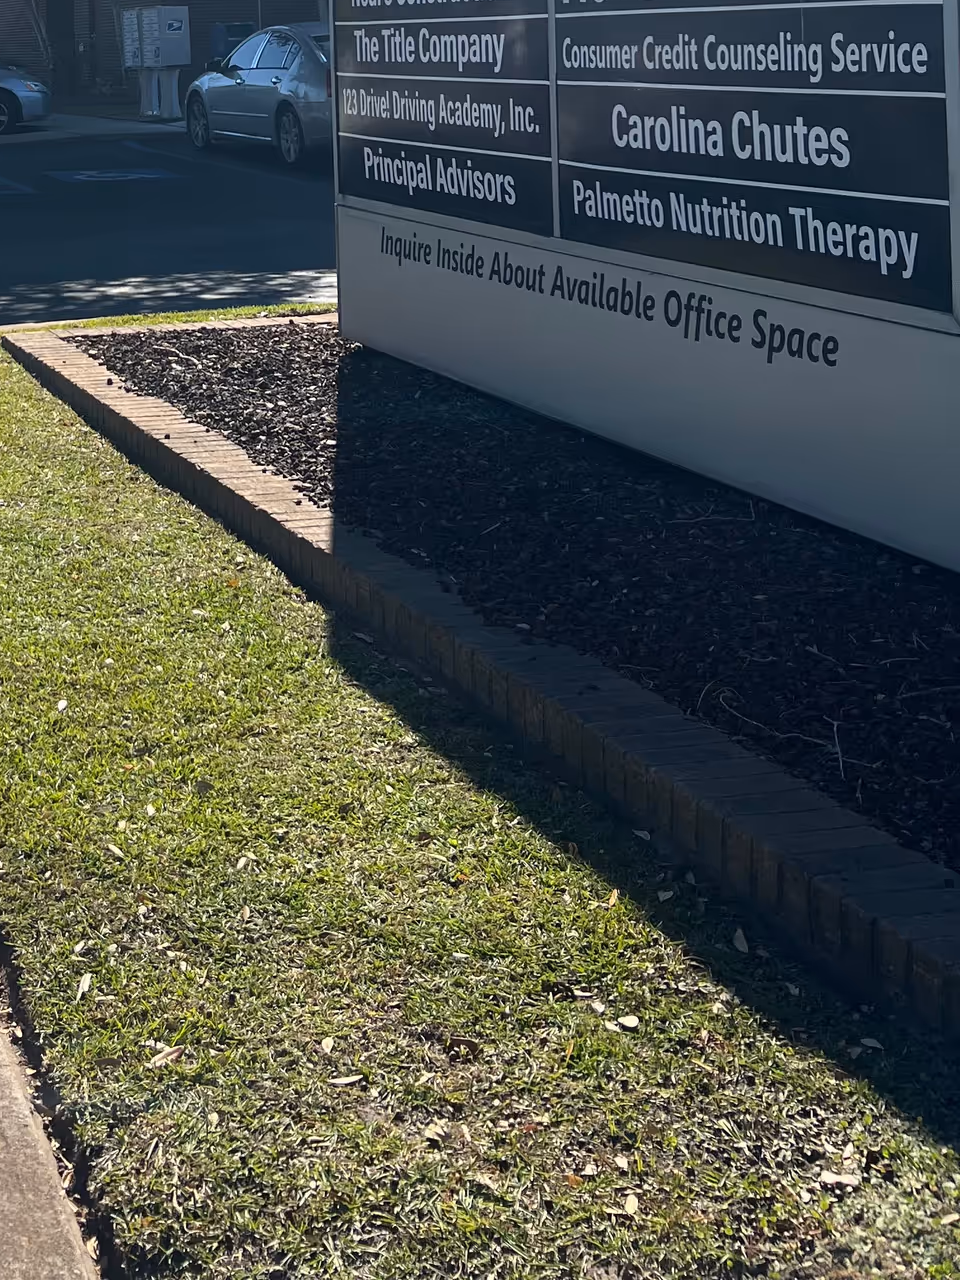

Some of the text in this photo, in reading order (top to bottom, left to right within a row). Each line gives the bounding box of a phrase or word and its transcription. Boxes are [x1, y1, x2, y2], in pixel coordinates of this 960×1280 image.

[354, 27, 505, 73] The Title Company
[562, 30, 928, 83] Consumer Credit Counseling Service
[342, 88, 540, 137] 123 Drive! Driving Academy, Inc.
[611, 104, 851, 168] Carolina Chutes
[363, 147, 516, 205] Principal Advisors
[572, 179, 919, 279] Palmetto Nutrition Therapy
[380, 226, 840, 367] Inquire Inside About Available Office Space
